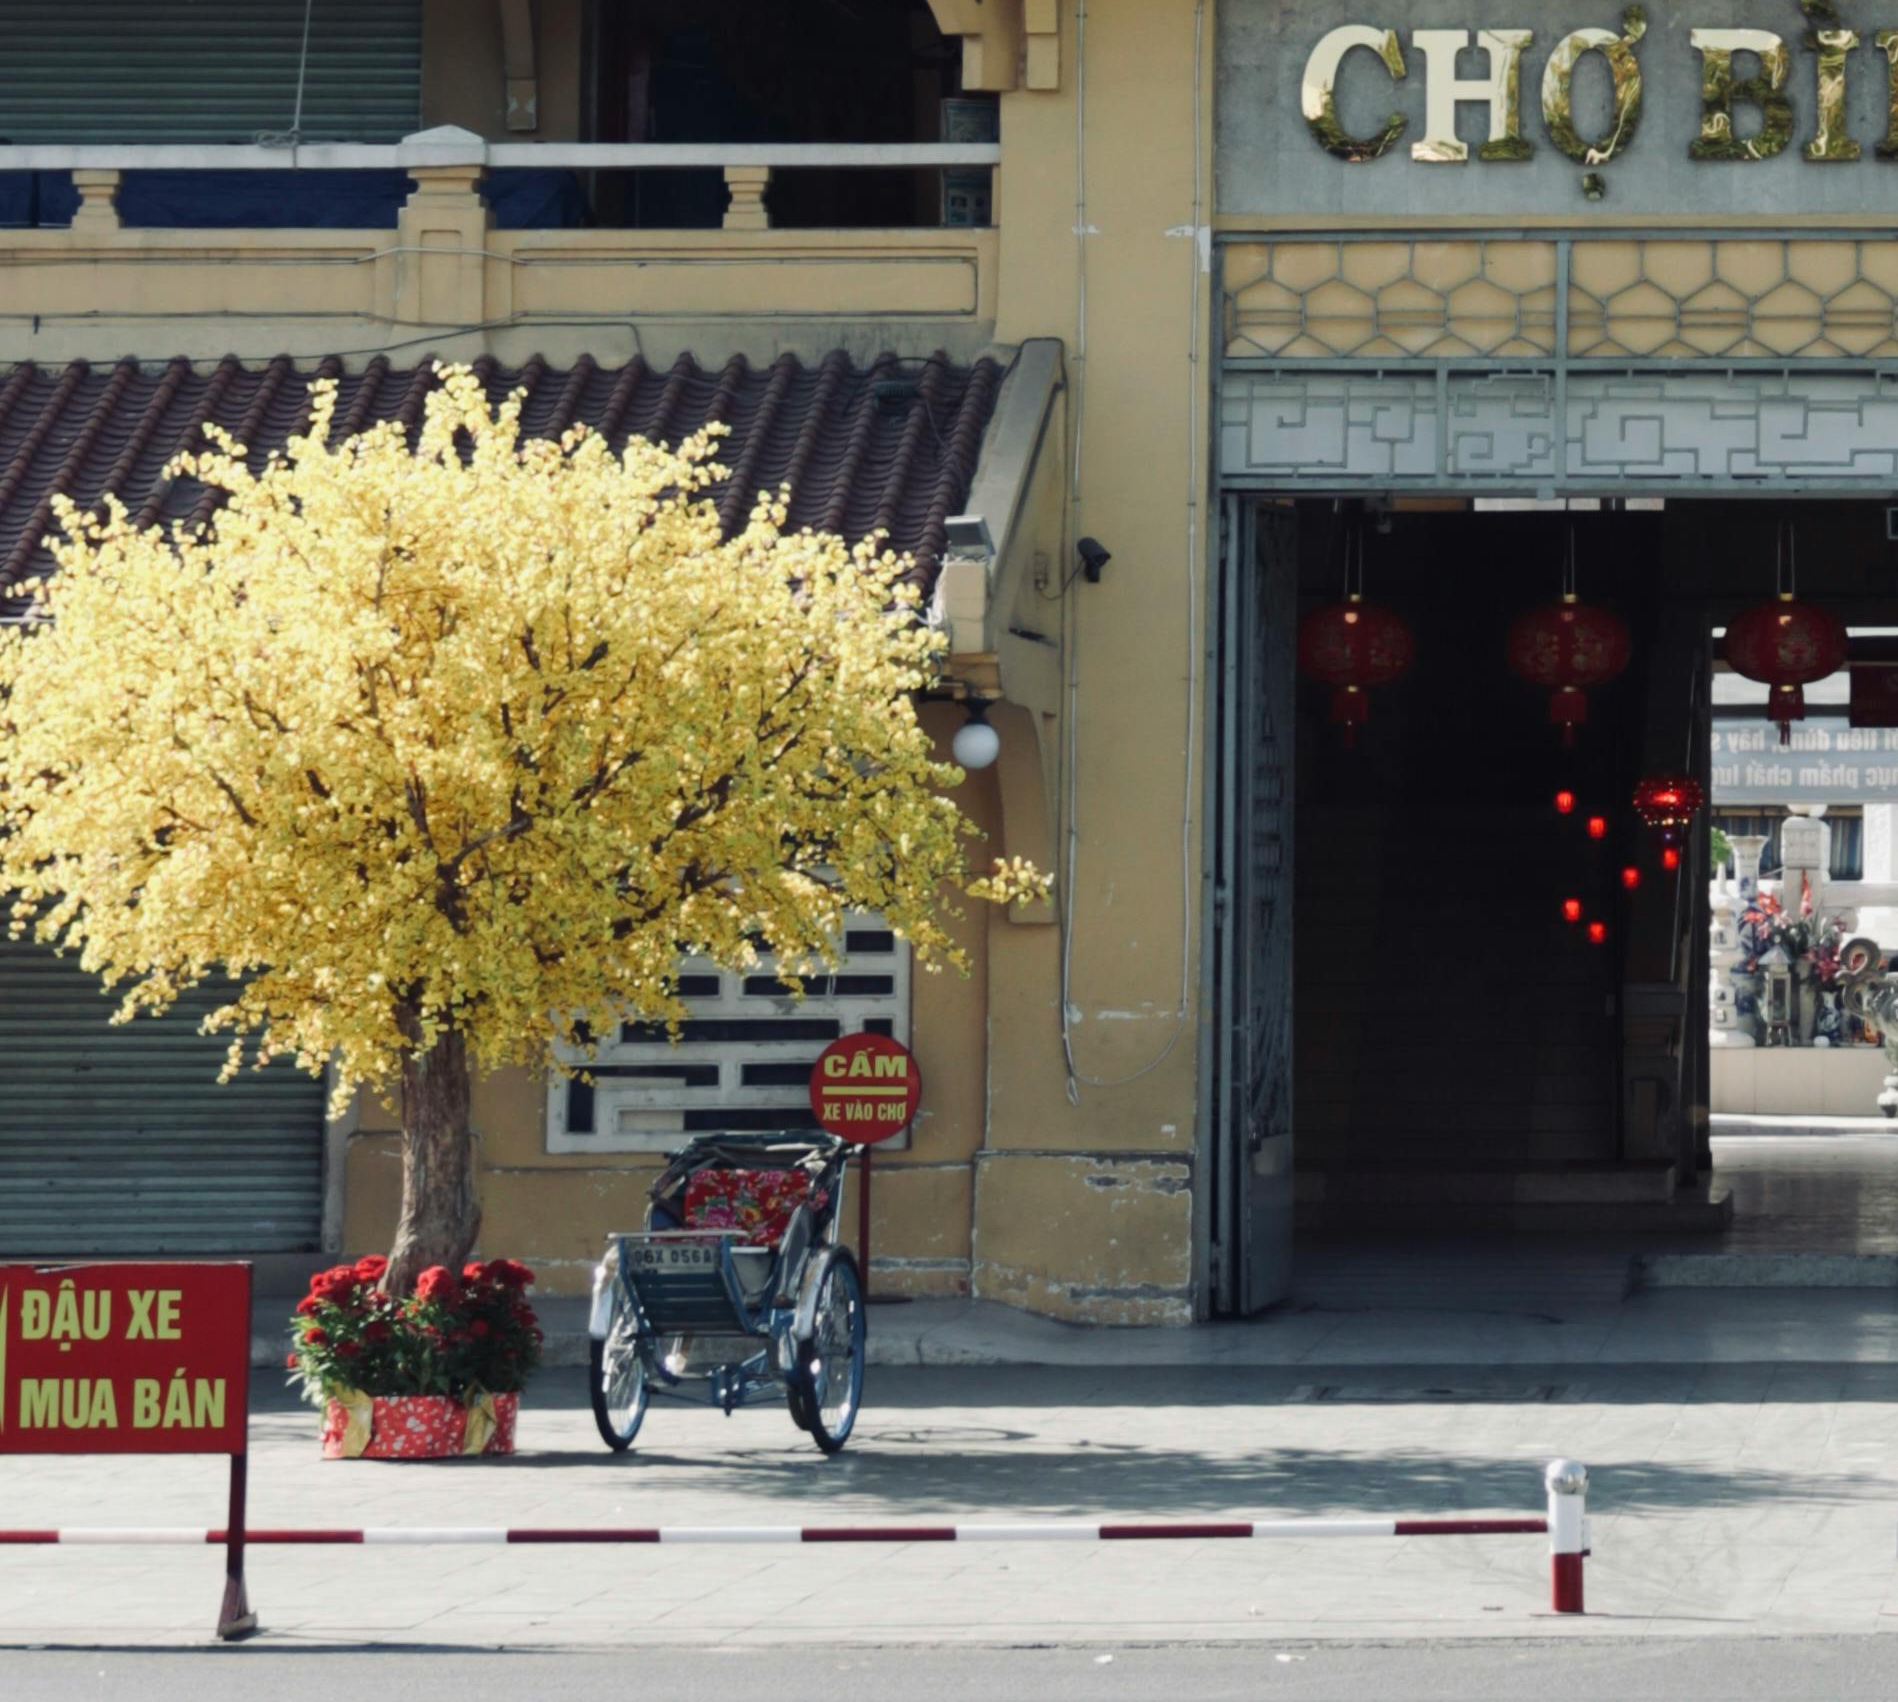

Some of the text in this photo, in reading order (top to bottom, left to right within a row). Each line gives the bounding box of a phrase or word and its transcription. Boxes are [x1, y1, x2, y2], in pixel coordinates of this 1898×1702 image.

[1302, 5, 1646, 199] CHỢ
[823, 1047, 908, 1078] CẤM
[822, 1099, 907, 1124] XE VÀO CHỢ
[20, 1278, 182, 1351] ĐẬU XE
[18, 1367, 226, 1429] MUA BÁN
